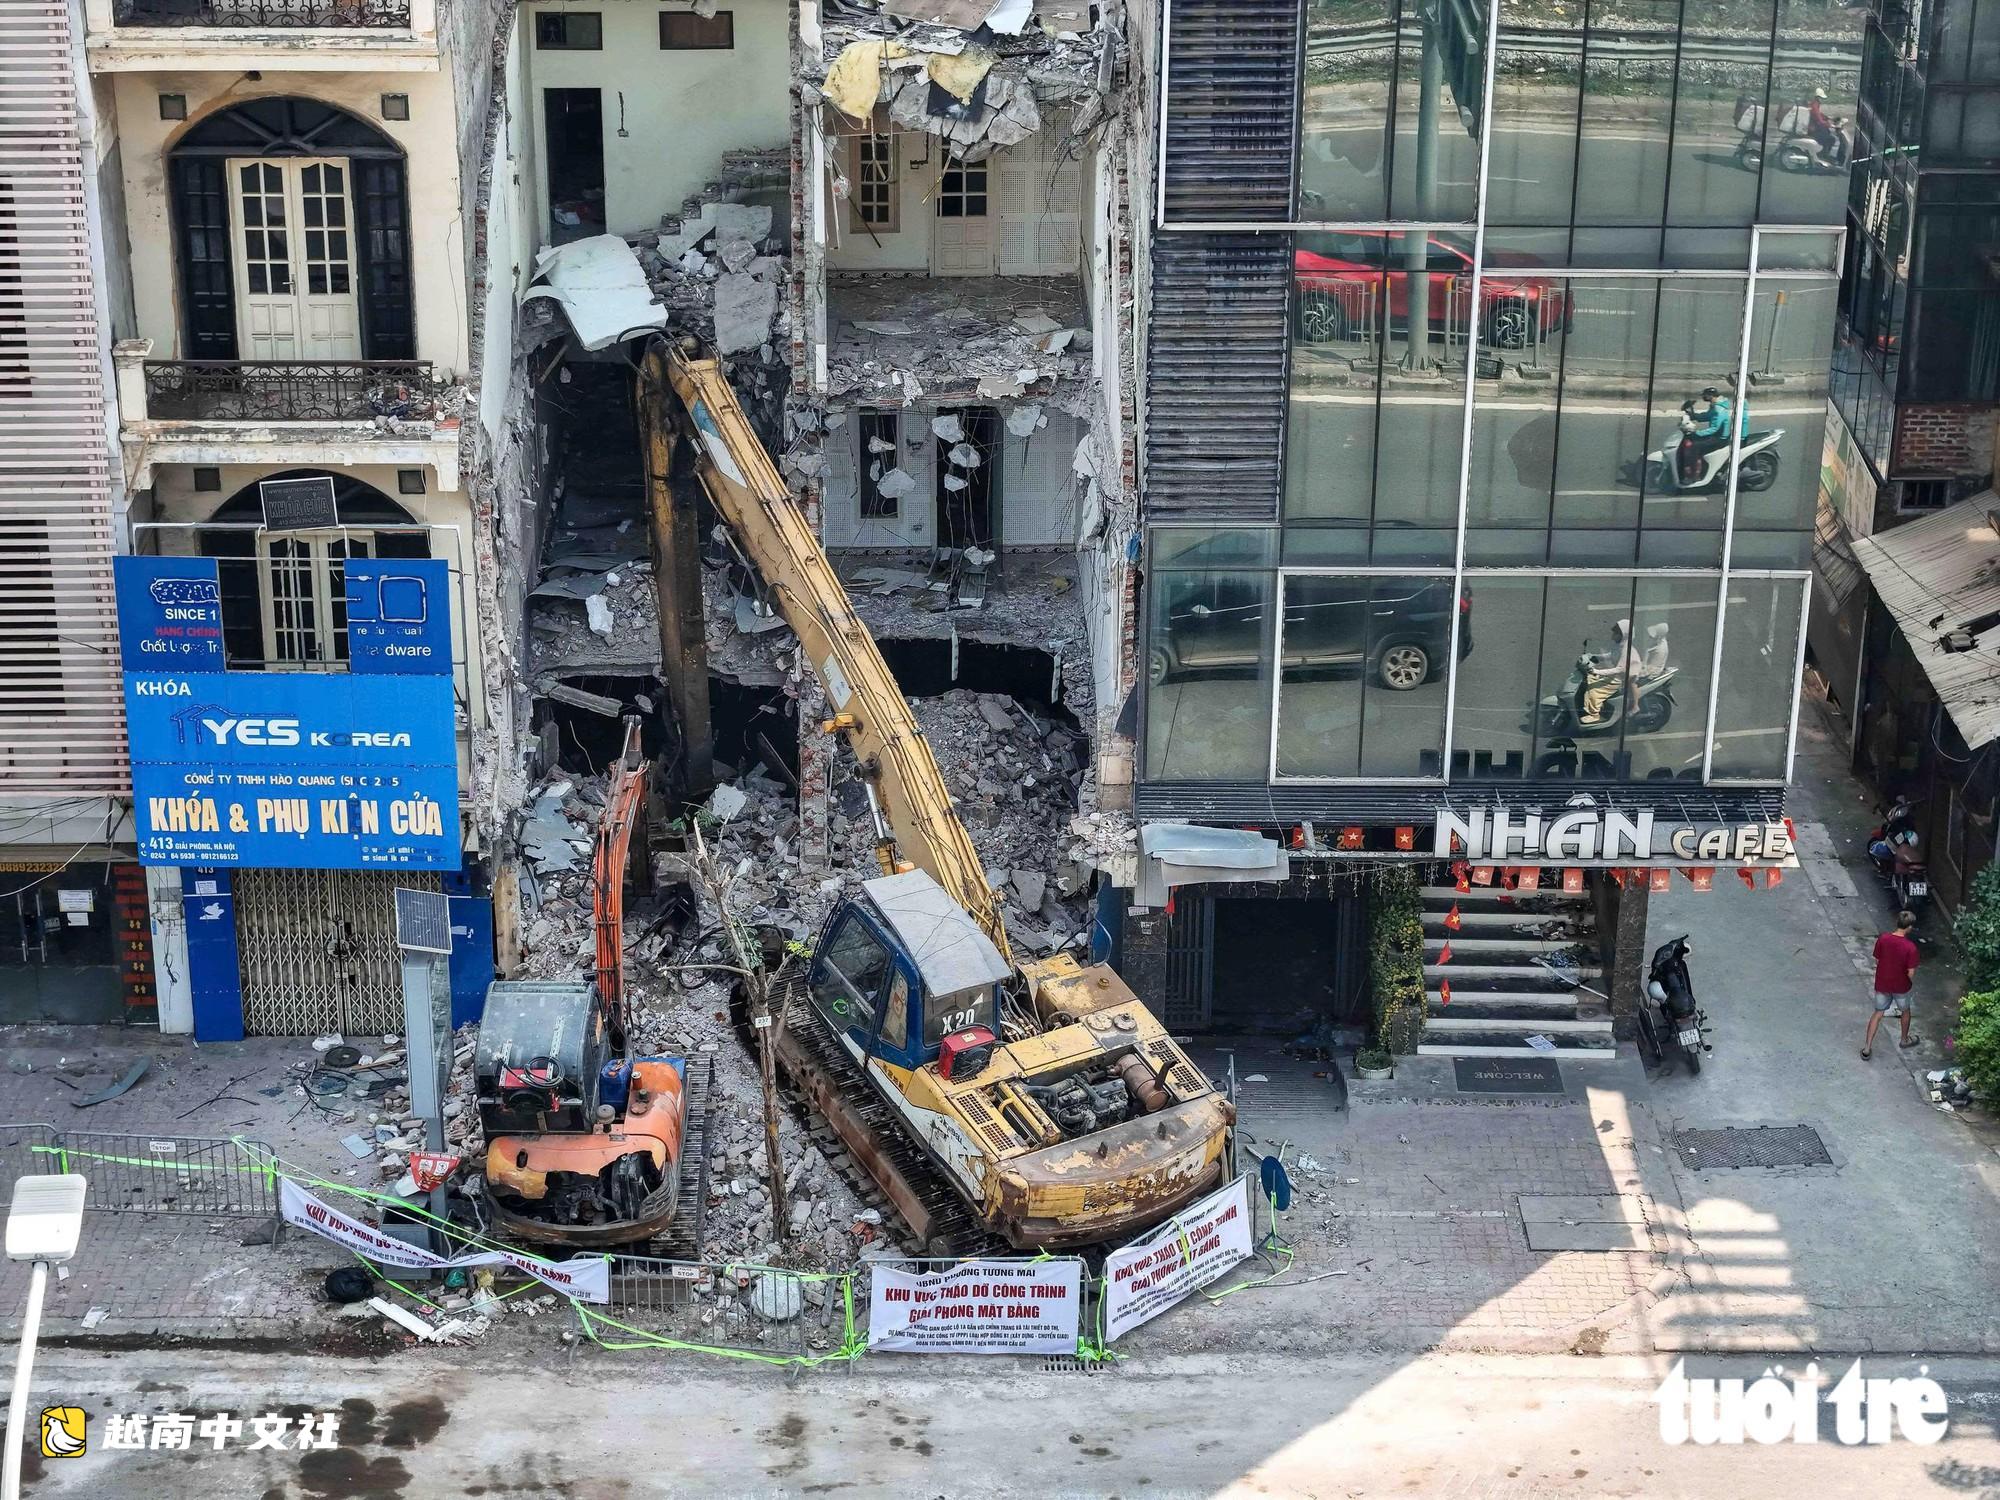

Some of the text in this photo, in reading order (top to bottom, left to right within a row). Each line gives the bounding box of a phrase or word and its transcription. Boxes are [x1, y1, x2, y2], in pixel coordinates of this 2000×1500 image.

[165, 608, 206, 620] SINCE
[140, 638, 167, 652] Chất
[135, 678, 192, 696] KHÓA
[202, 719, 300, 746] YES
[184, 772, 214, 785] CÔNG
[218, 775, 232, 785] TY
[237, 775, 266, 785] TNHH
[270, 772, 293, 786] HÀO
[298, 775, 335, 787] QUANG
[149, 790, 220, 833] KHÓA
[229, 803, 249, 833] &
[256, 798, 310, 840] PHỤ
[390, 791, 443, 836] CỬA
[1434, 793, 1789, 860] NHÂN CAFE
[149, 836, 174, 850] 413
[1016, 1268, 1036, 1278] MAI
[885, 1287, 911, 1302] KHU
[972, 1282, 990, 1298] DỠ
[992, 1282, 1026, 1299] CÔNG
[1029, 1283, 1066, 1299] TRÌNH
[934, 1303, 974, 1320] PHÓNG
[977, 1302, 1004, 1321] MẶT
[1007, 1301, 1040, 1319] BẰNG
